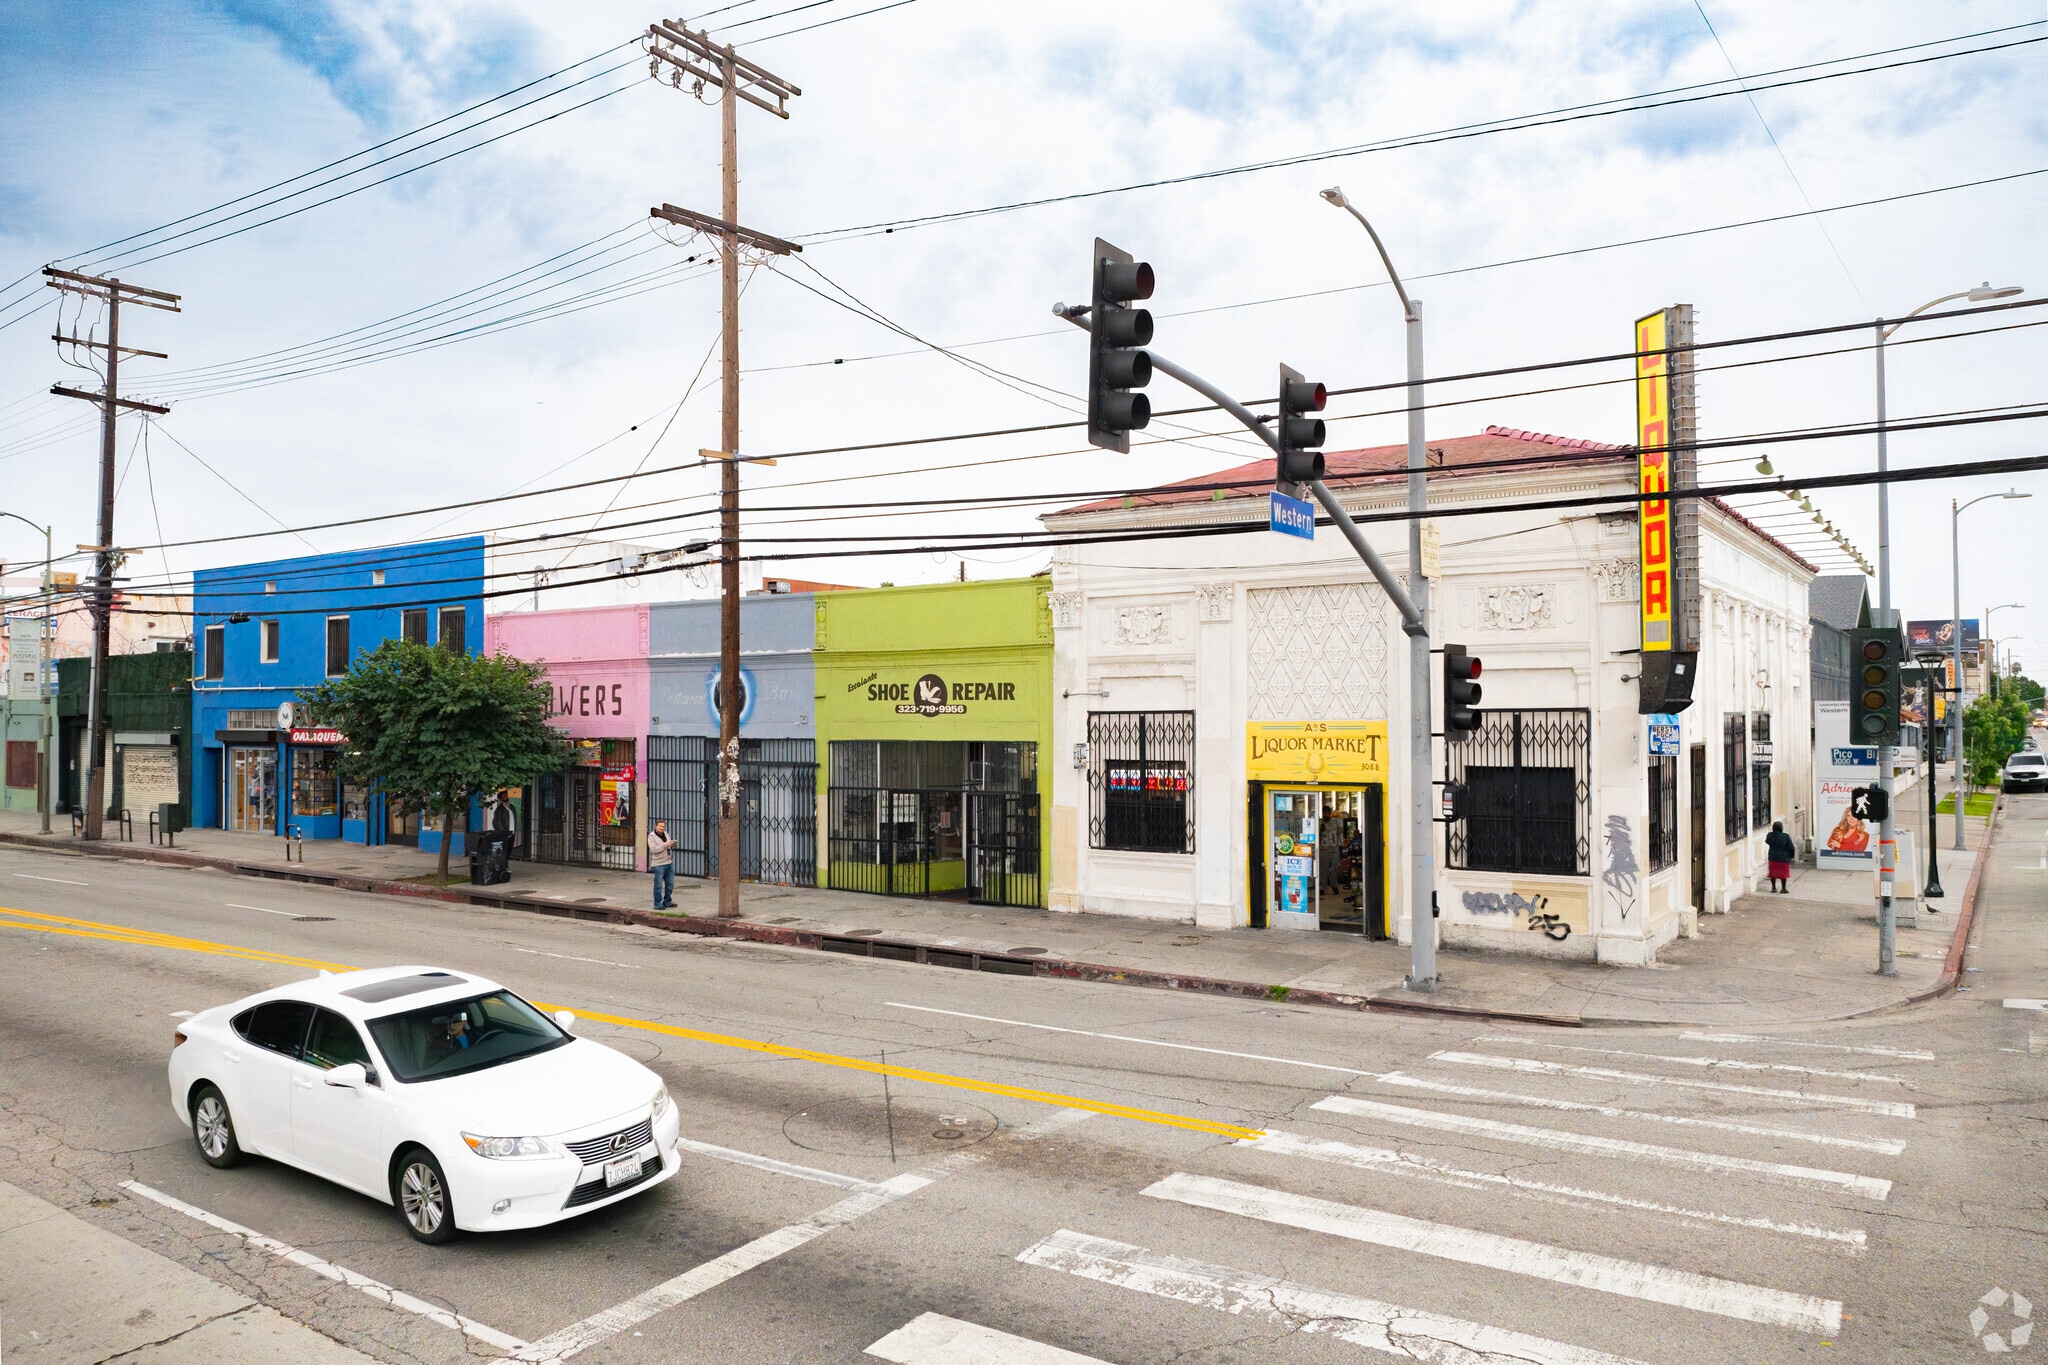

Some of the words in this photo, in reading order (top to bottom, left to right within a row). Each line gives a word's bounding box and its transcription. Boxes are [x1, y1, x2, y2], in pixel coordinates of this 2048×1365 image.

[1641, 326, 1667, 615] LIQUOR
[1273, 502, 1312, 532] Western
[868, 683, 909, 701] SHOE
[952, 682, 1015, 700] REPAIR
[1251, 735, 1308, 760] LIQUOR
[1312, 734, 1381, 761] MARKET
[1833, 749, 1852, 758] Pico
[1361, 763, 1380, 771] 3088
[1278, 800, 1285, 809] A
